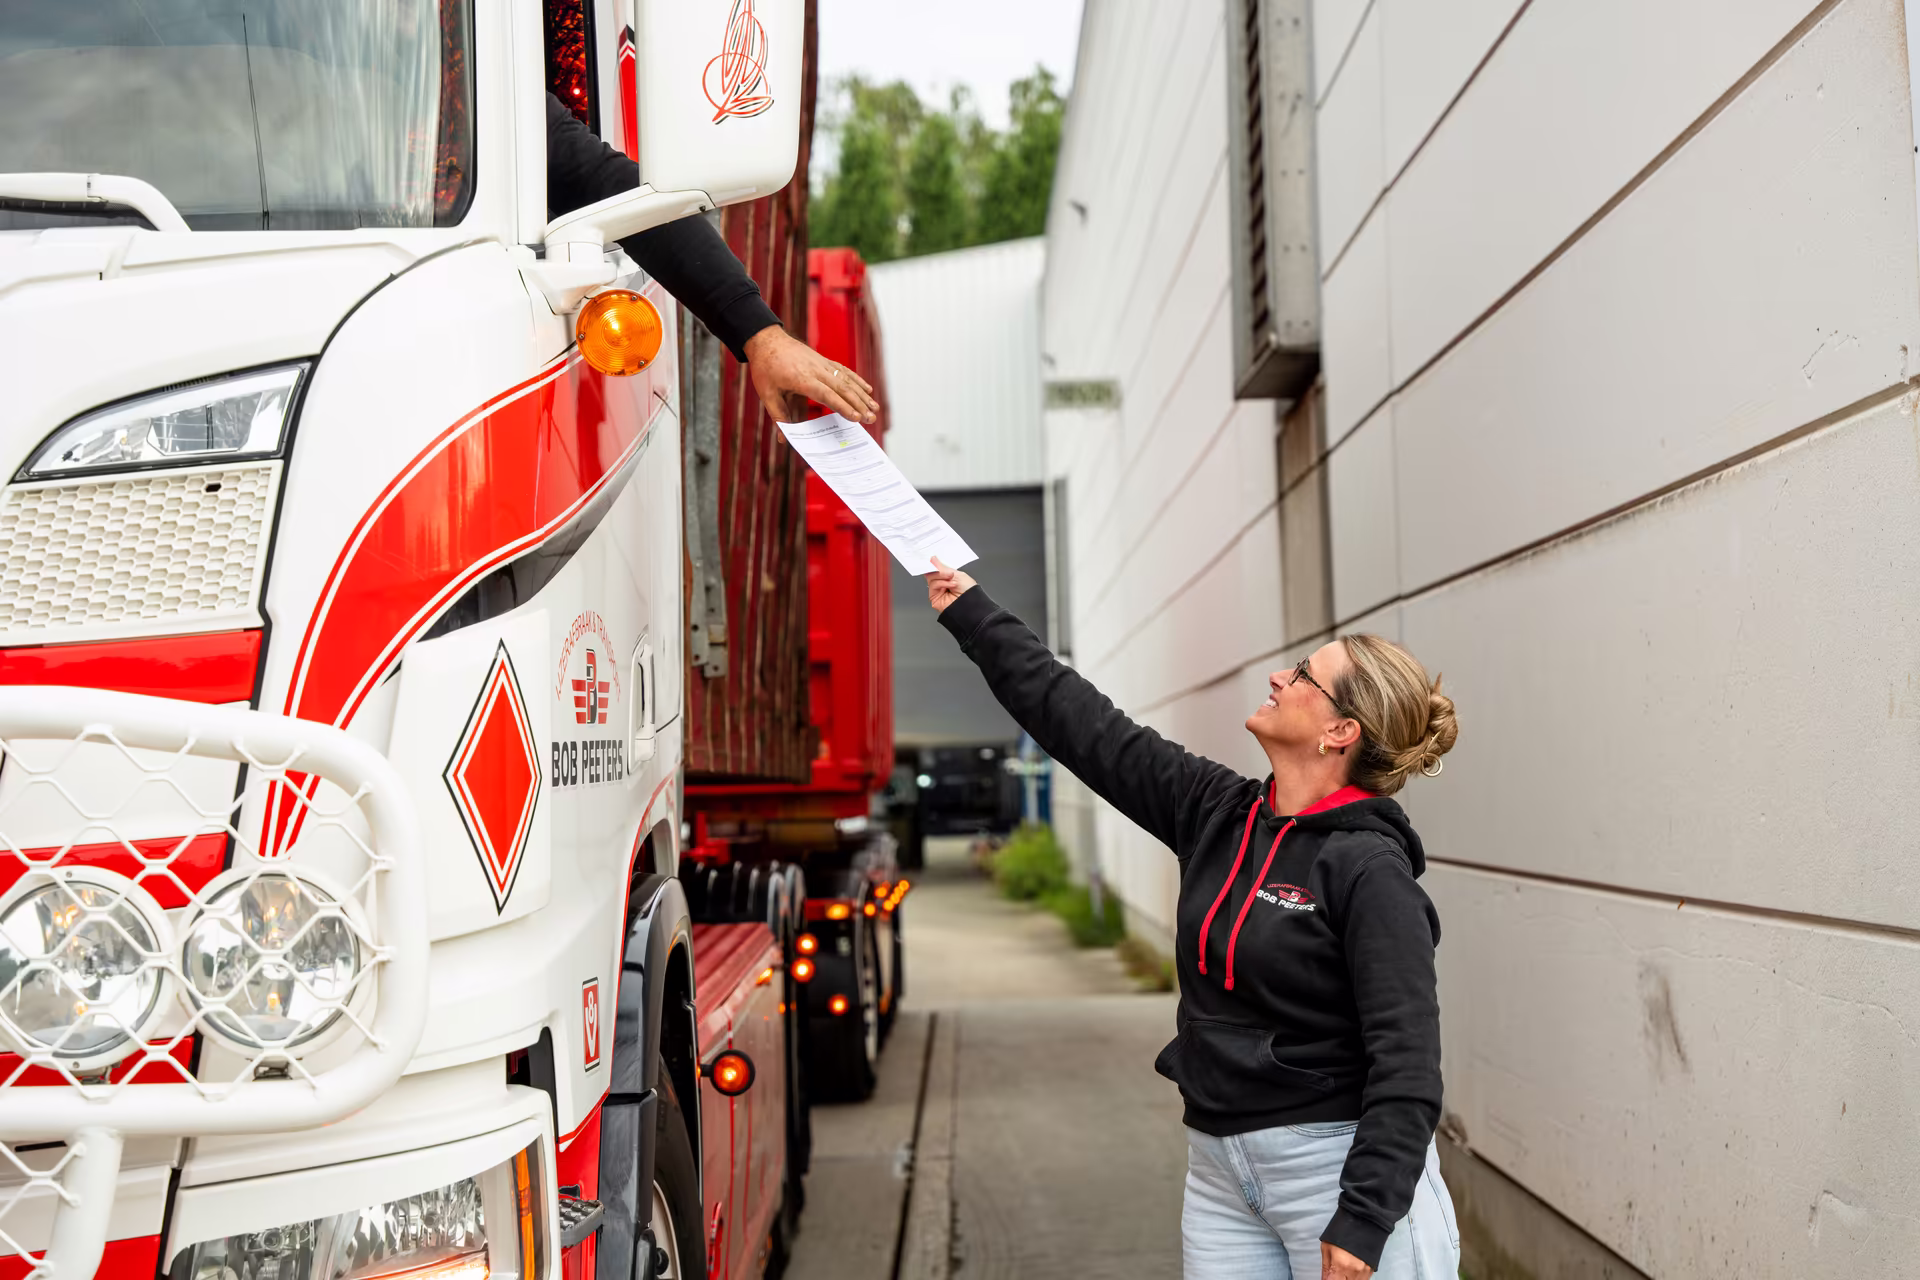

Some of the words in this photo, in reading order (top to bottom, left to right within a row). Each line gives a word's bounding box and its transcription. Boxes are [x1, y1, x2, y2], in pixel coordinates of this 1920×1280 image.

[551, 741, 578, 787] BOB
[581, 739, 623, 785] PEETERS
[1256, 889, 1278, 903] BOB
[1278, 899, 1316, 912] PEETERS
